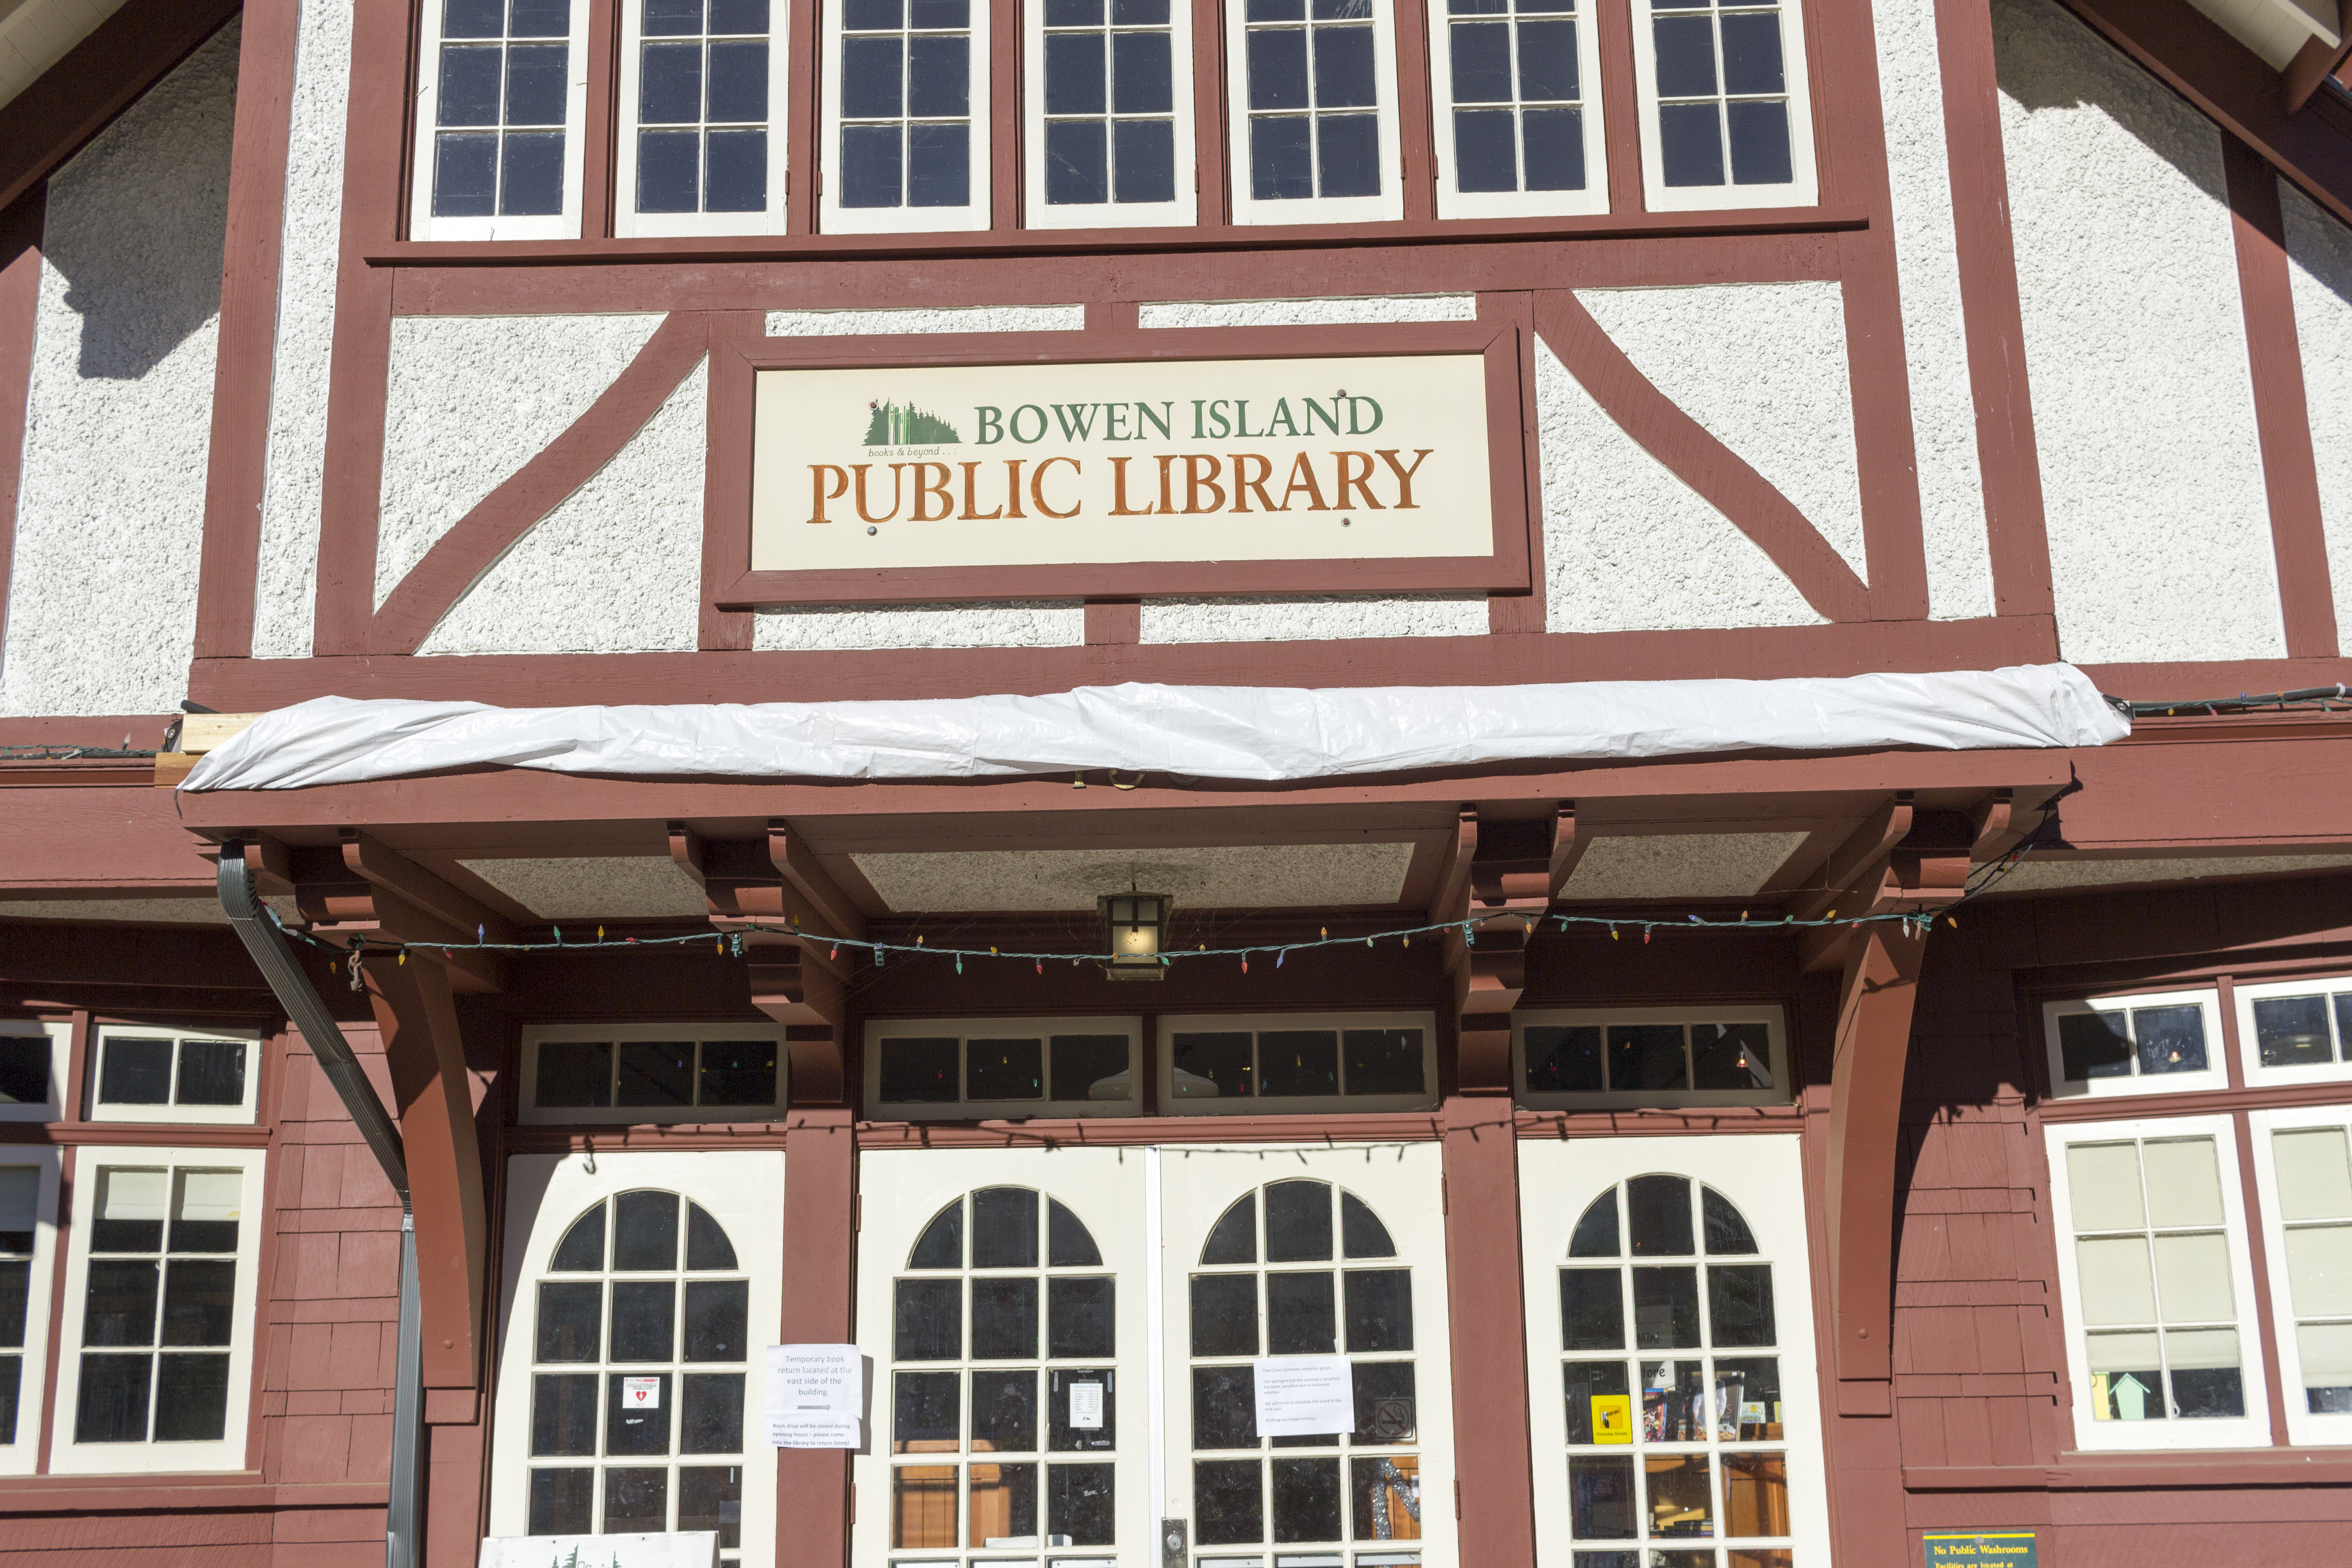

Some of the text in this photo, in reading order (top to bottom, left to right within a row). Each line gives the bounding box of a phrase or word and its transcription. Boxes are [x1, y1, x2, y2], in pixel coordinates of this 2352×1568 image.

[974, 396, 1383, 445] BOWEN ISLAND
[868, 448, 893, 456] books
[897, 447, 904, 456] &
[907, 446, 939, 458] beyond
[807, 449, 1434, 524] PUBLIC LIBRARY
[1642, 1367, 1665, 1378] tore
[1602, 1409, 1620, 1423] Interac
[1934, 1545, 2028, 1555] No Public Washrooms
